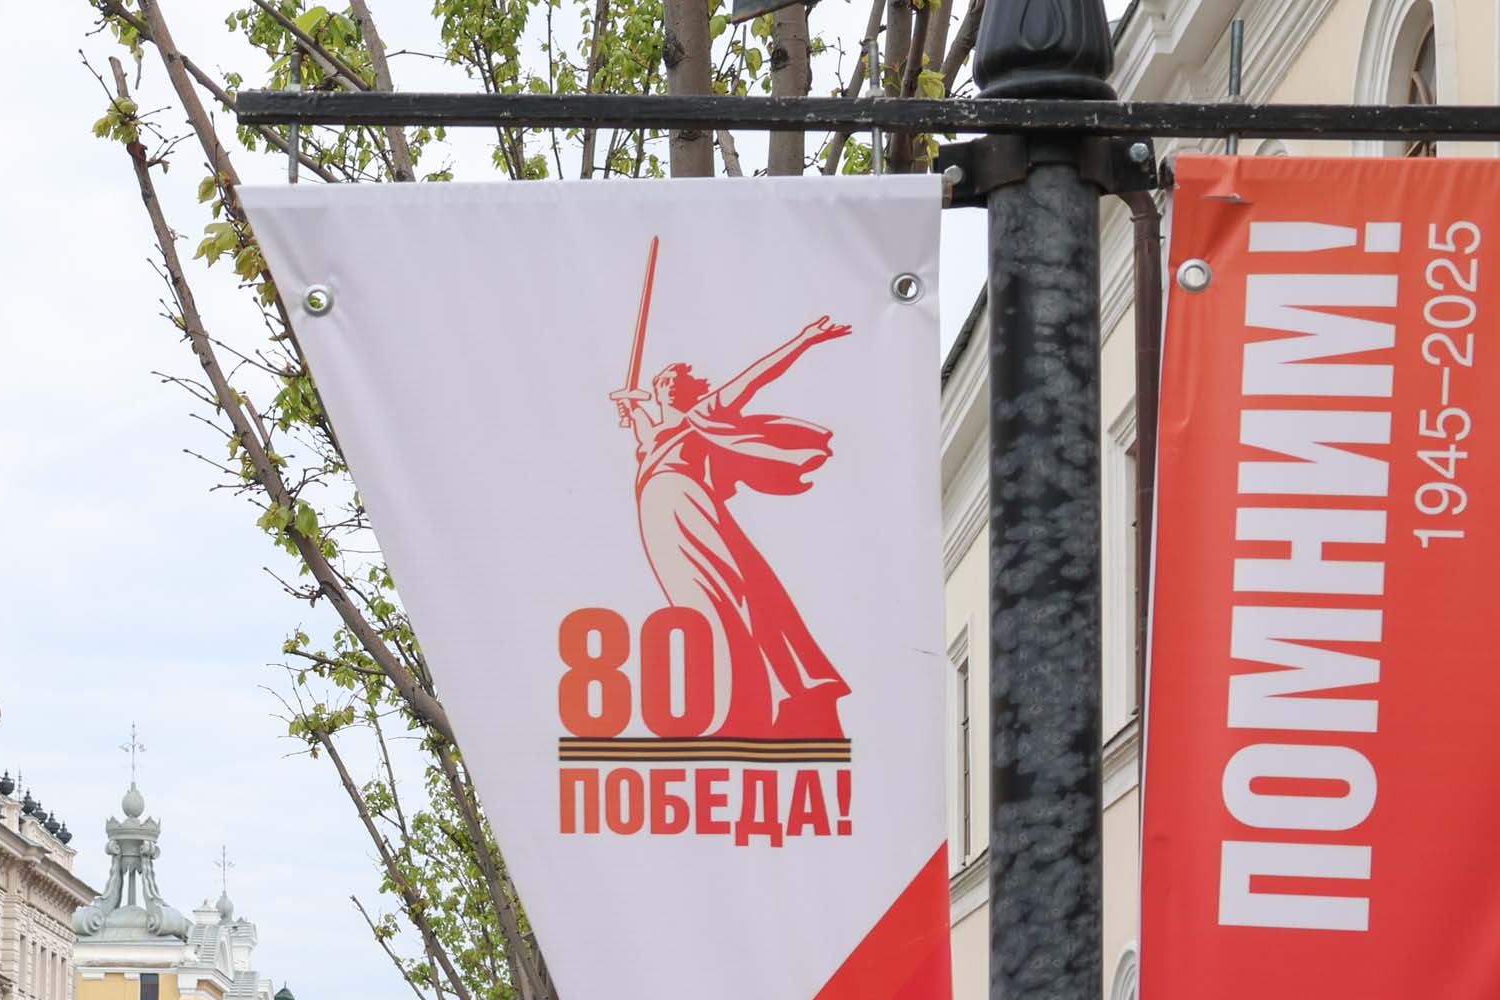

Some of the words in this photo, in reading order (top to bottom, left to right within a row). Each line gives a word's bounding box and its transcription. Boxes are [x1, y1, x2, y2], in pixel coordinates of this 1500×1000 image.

[1218, 220, 1402, 932] ПОМНИМ!
[558, 606, 716, 738] 80
[558, 767, 852, 847] ПОБЕДА!
